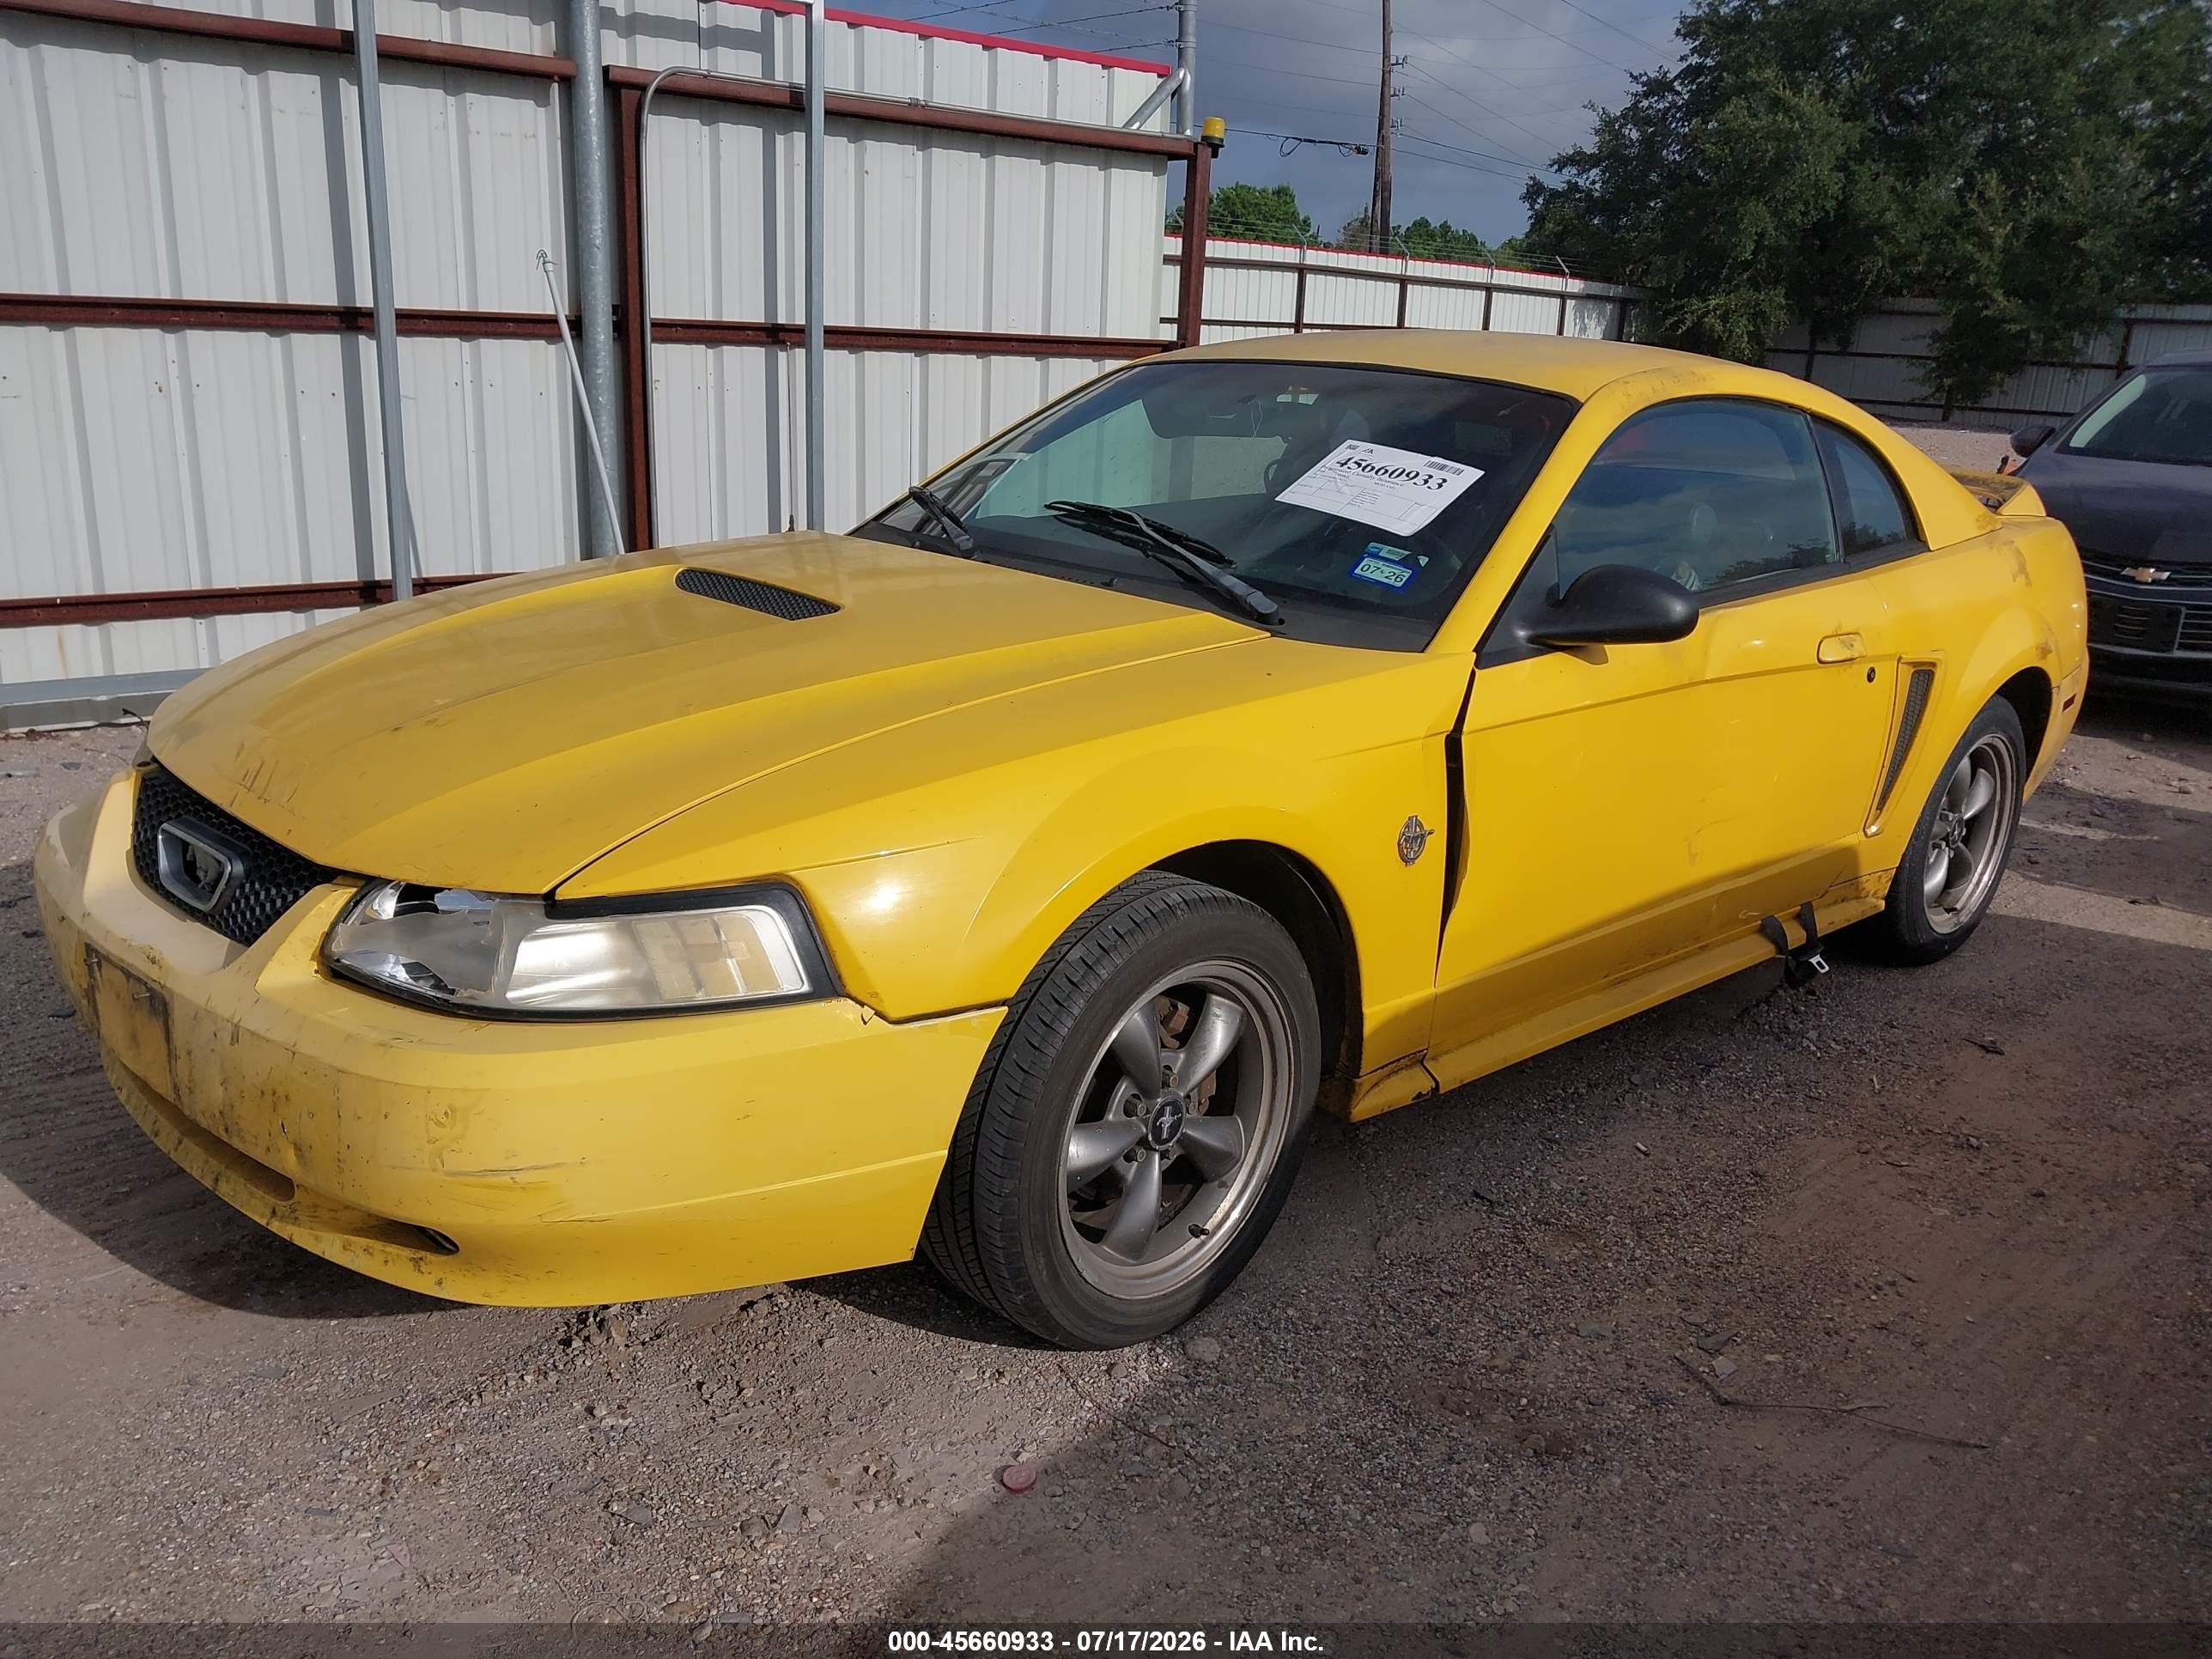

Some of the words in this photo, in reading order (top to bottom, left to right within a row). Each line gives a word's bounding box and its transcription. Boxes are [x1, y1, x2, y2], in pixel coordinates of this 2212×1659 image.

[1336, 456, 1448, 490] 45660933
[1360, 563, 1382, 574] 07
[1383, 571, 1406, 583] 26
